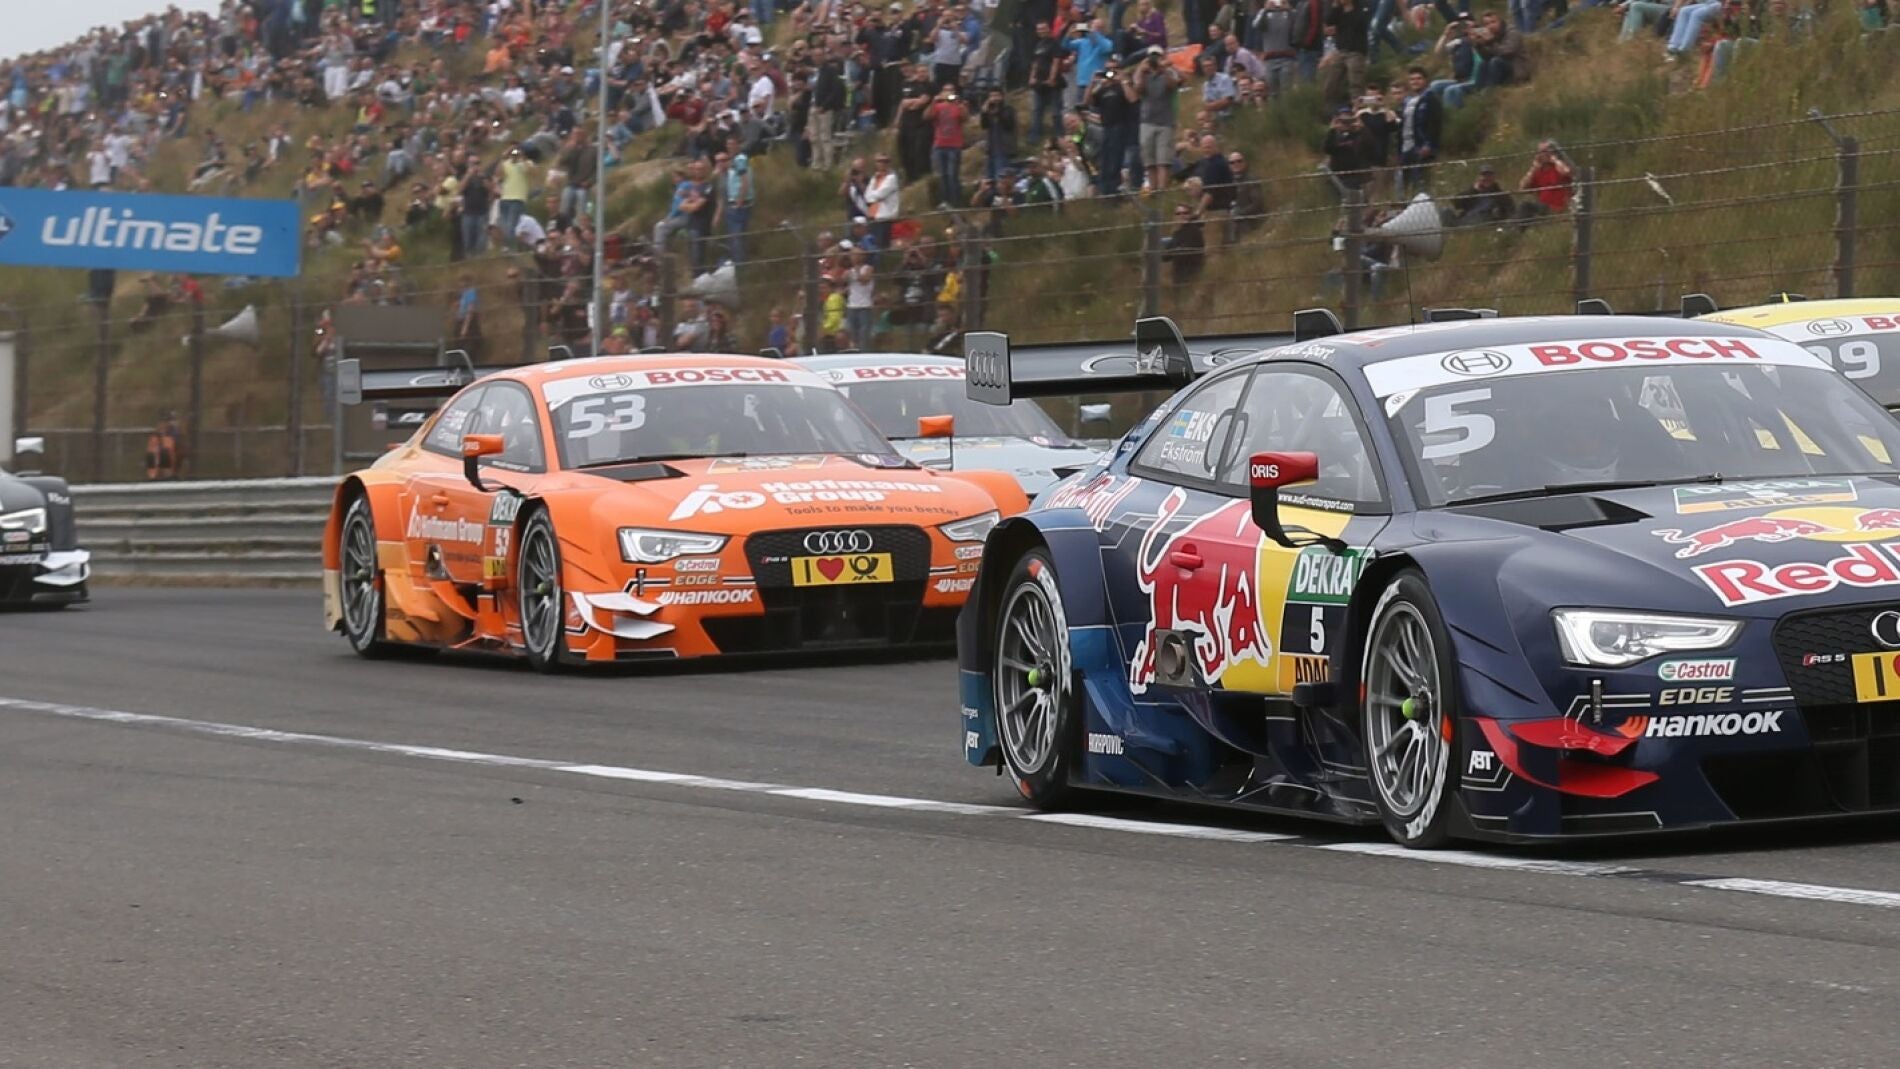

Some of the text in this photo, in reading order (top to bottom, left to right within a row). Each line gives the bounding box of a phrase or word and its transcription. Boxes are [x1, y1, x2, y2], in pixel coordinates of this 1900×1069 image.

[42, 206, 262, 254] ultimate
[1862, 315, 1900, 330] B
[1529, 338, 1761, 367] BOSCH
[645, 368, 790, 385] BOSCH
[568, 394, 646, 439] 53
[1184, 410, 1217, 442] EKS
[1422, 388, 1496, 460] 5
[1251, 463, 1280, 478] ORIS
[760, 479, 942, 493] Hoffmann
[772, 489, 885, 504] Group
[785, 504, 959, 517] Tools to make you better
[686, 560, 717, 570] Castrol
[804, 559, 812, 583] I
[1295, 554, 1353, 596] DEKRA
[1697, 543, 1898, 604] Red
[675, 575, 718, 585] EDGE
[1310, 606, 1325, 654] 5
[1811, 653, 1846, 664] RS 5
[1676, 662, 1732, 681] Castrol
[1873, 655, 1886, 697] I
[1659, 686, 1735, 706] EDGE
[1469, 750, 1494, 775] ABT
